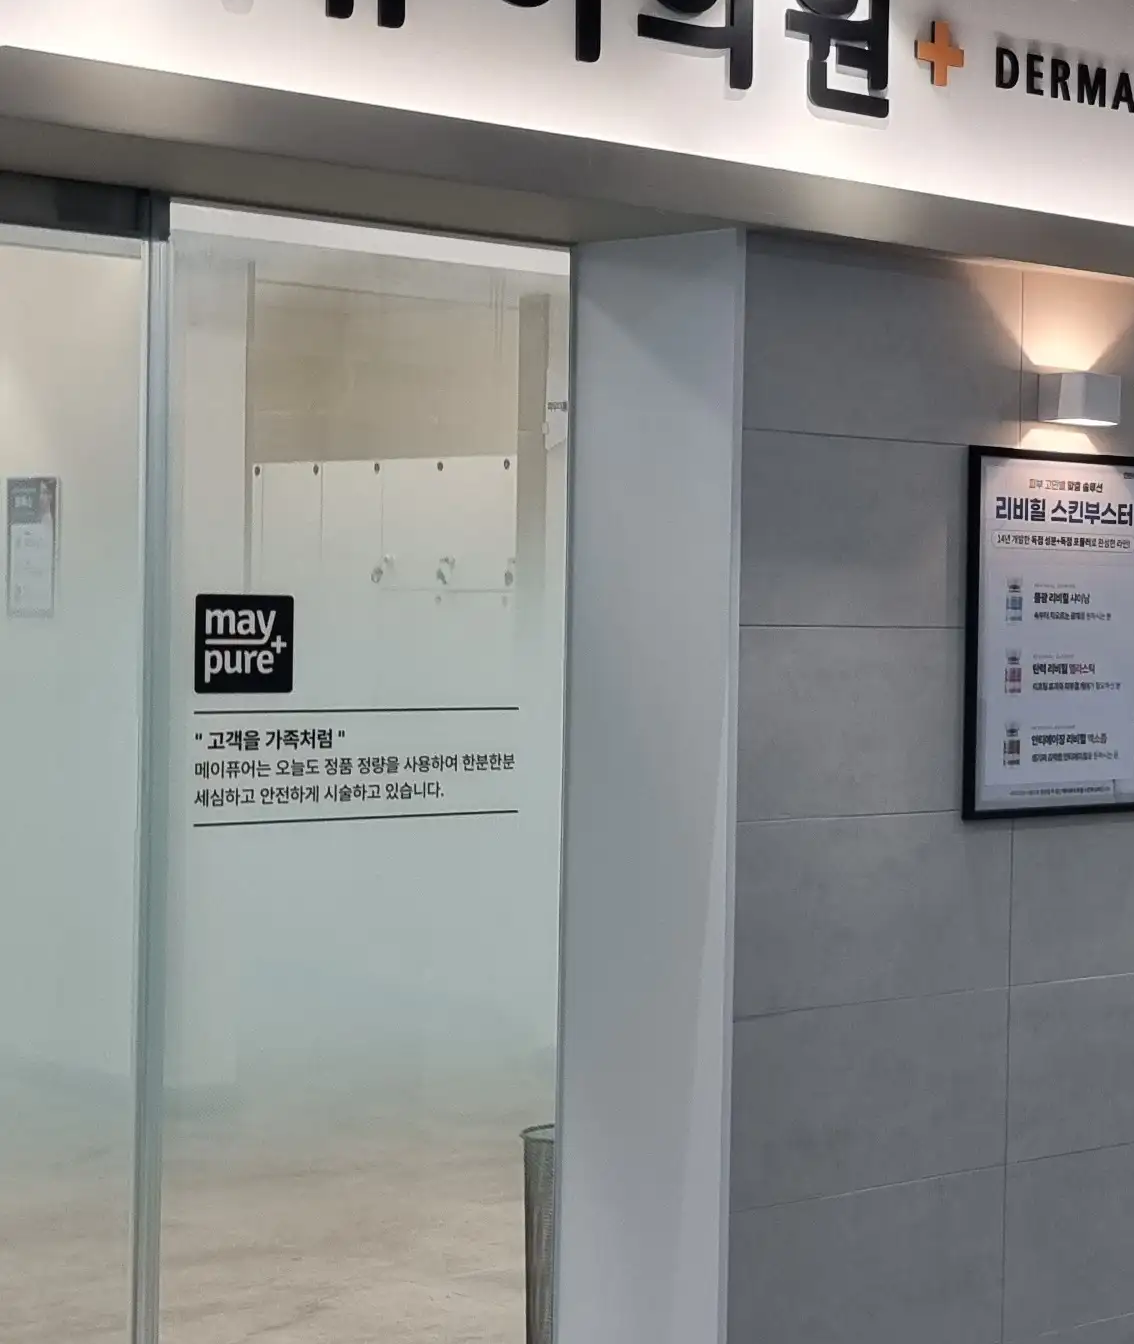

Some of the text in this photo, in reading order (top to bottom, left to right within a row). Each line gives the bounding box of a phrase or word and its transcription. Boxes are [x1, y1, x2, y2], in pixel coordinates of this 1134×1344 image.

[996, 496, 1133, 526] 리비힐 스킨부스터
[205, 608, 277, 646] may
[207, 730, 261, 751] 고객을
[265, 729, 333, 750] 가족처럼
[194, 753, 515, 779] 메이퓨어는 오늘도 정품 정량을 사용하여 한분한분
[194, 781, 445, 808] 세심하고 안전하게 시술하고 있습니다.
